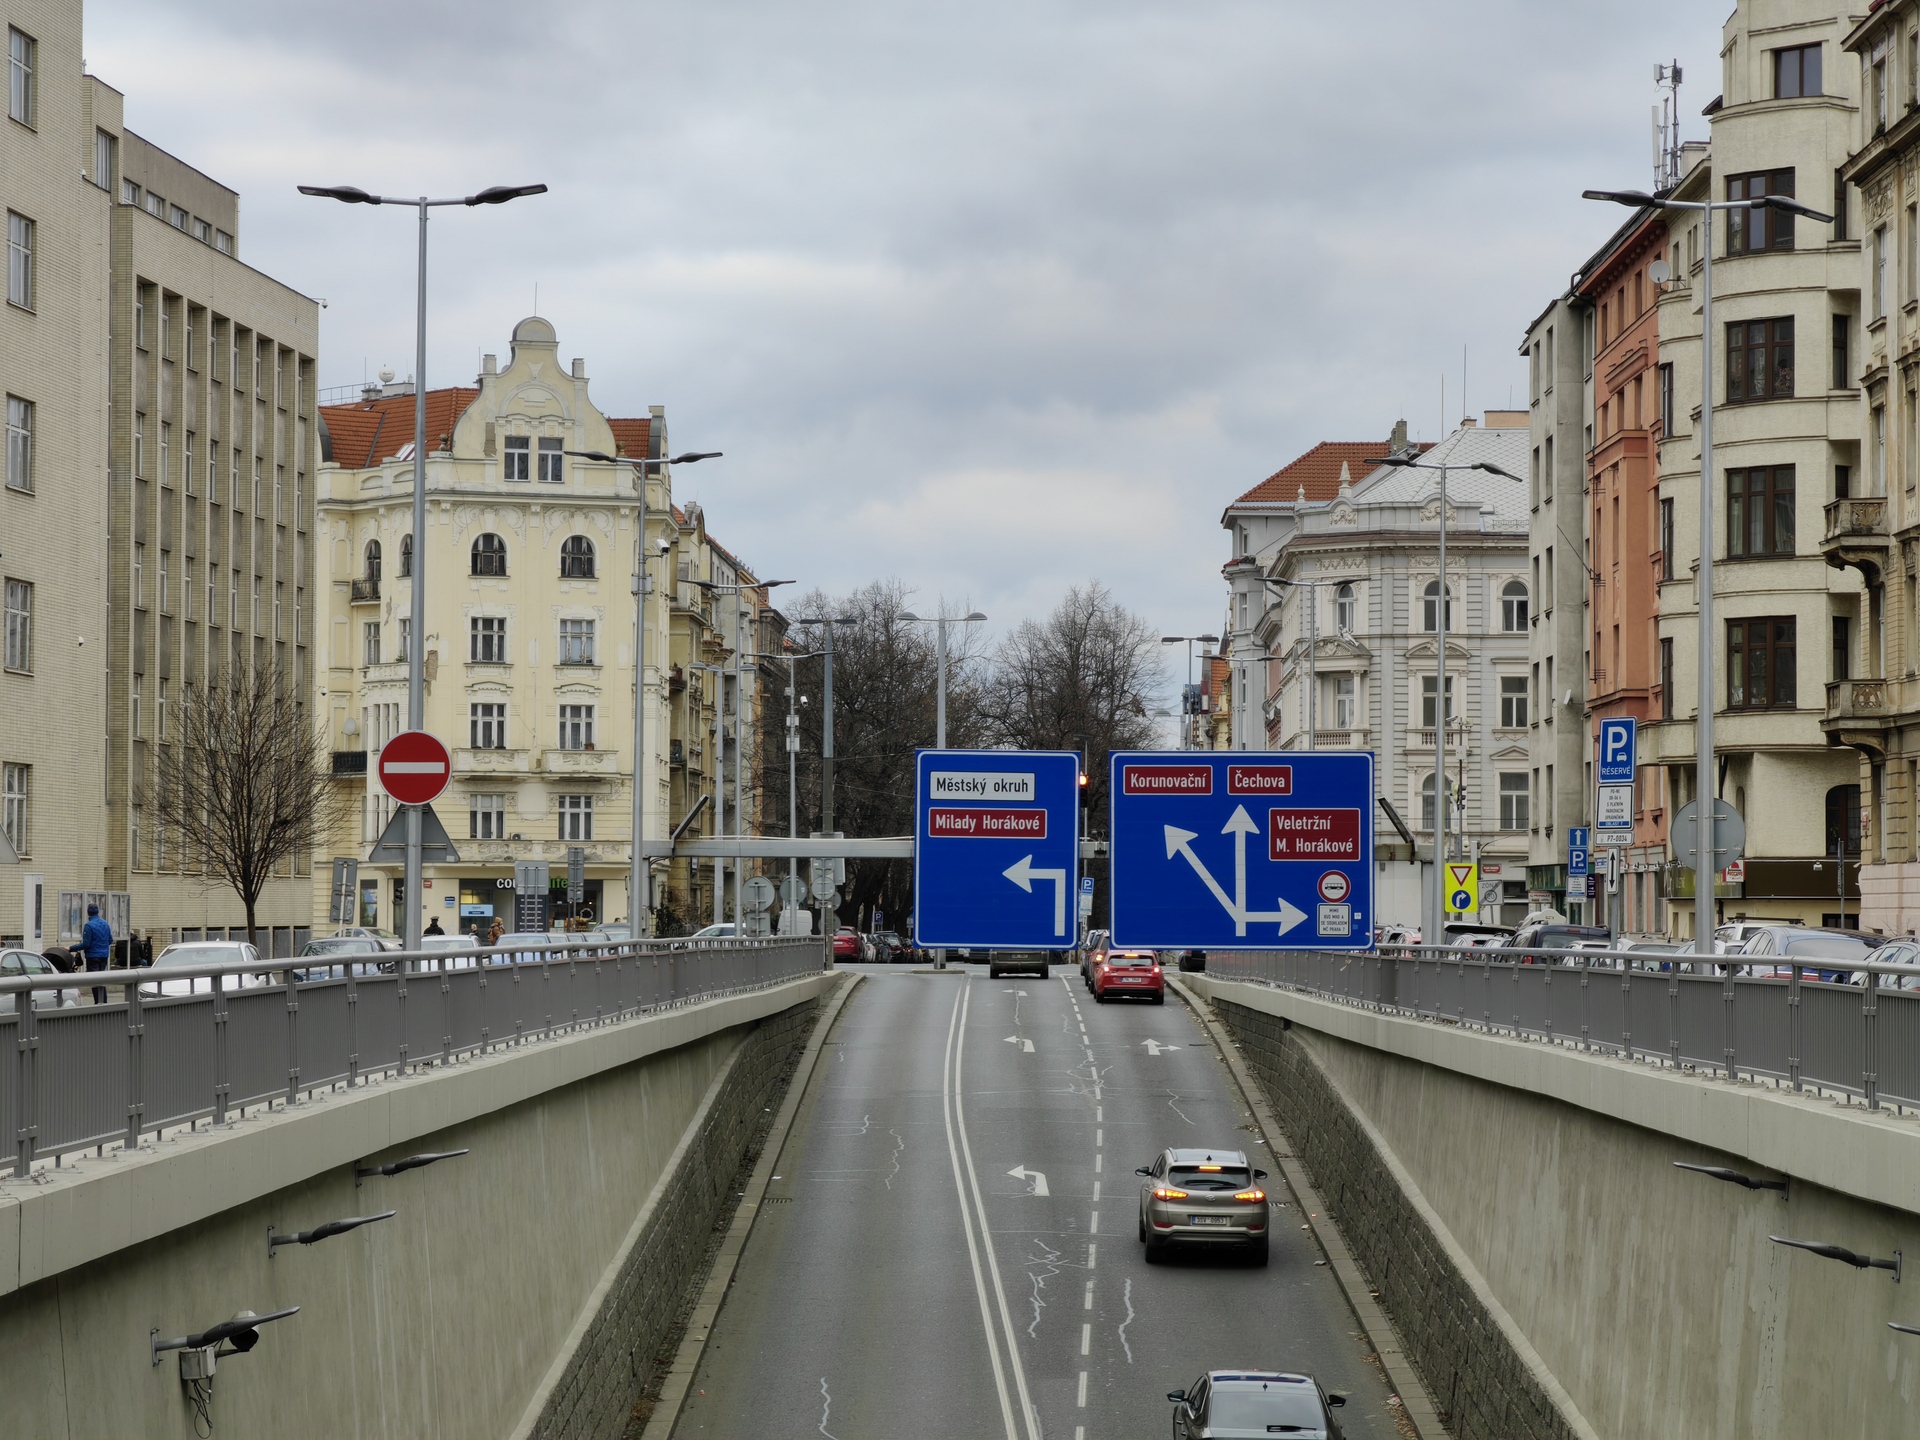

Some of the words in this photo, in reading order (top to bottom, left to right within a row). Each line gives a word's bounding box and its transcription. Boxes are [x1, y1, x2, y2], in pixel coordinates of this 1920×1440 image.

[1606, 726, 1628, 763] P
[1235, 769, 1285, 788] Čechova
[1601, 766, 1631, 775] RÉSERVÉ
[936, 777, 987, 795] Městský
[993, 778, 1029, 793] okruh
[1130, 773, 1207, 788] Korunovační
[935, 814, 977, 832] Milady
[983, 814, 1040, 830] Horákové
[1276, 815, 1332, 830] Veletržní
[1276, 838, 1290, 853] M.
[1296, 837, 1353, 853] Horákové
[1572, 851, 1584, 867] P
